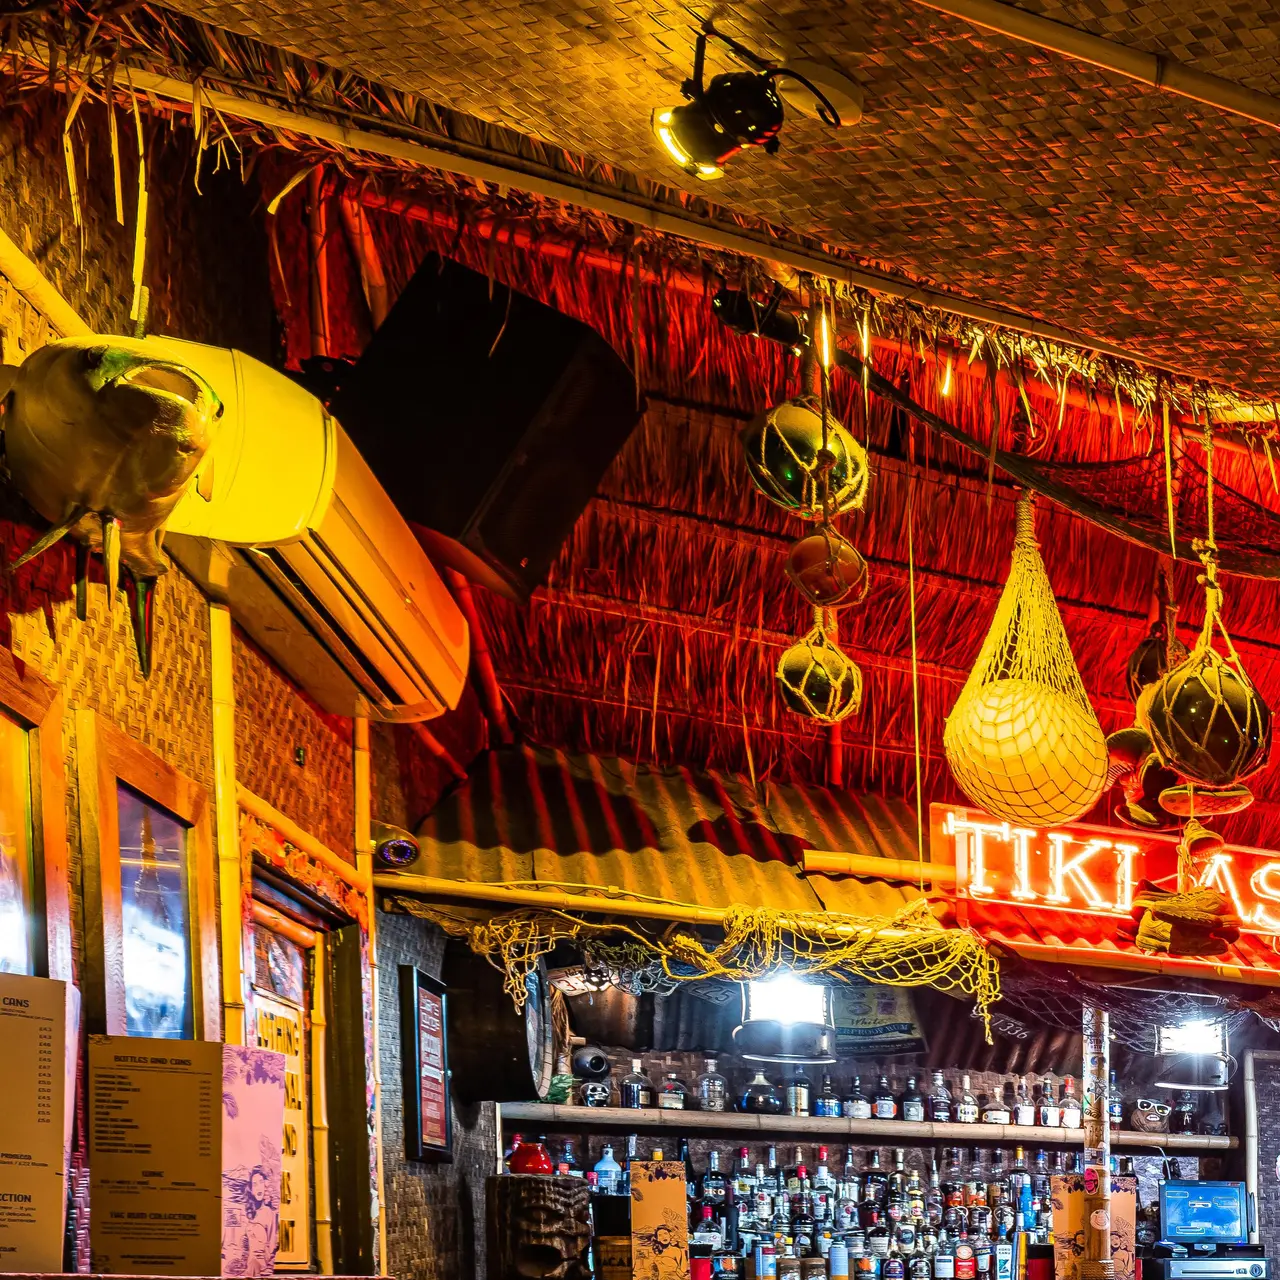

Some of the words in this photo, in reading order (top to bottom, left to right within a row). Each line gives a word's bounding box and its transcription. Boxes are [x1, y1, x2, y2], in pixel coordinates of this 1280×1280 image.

[942, 811, 1140, 913] TIKI
[2, 996, 30, 1008] CANS
[114, 1054, 149, 1064] BOTTLES
[150, 1057, 168, 1065] AND
[149, 1212, 197, 1221] COLLECTION
